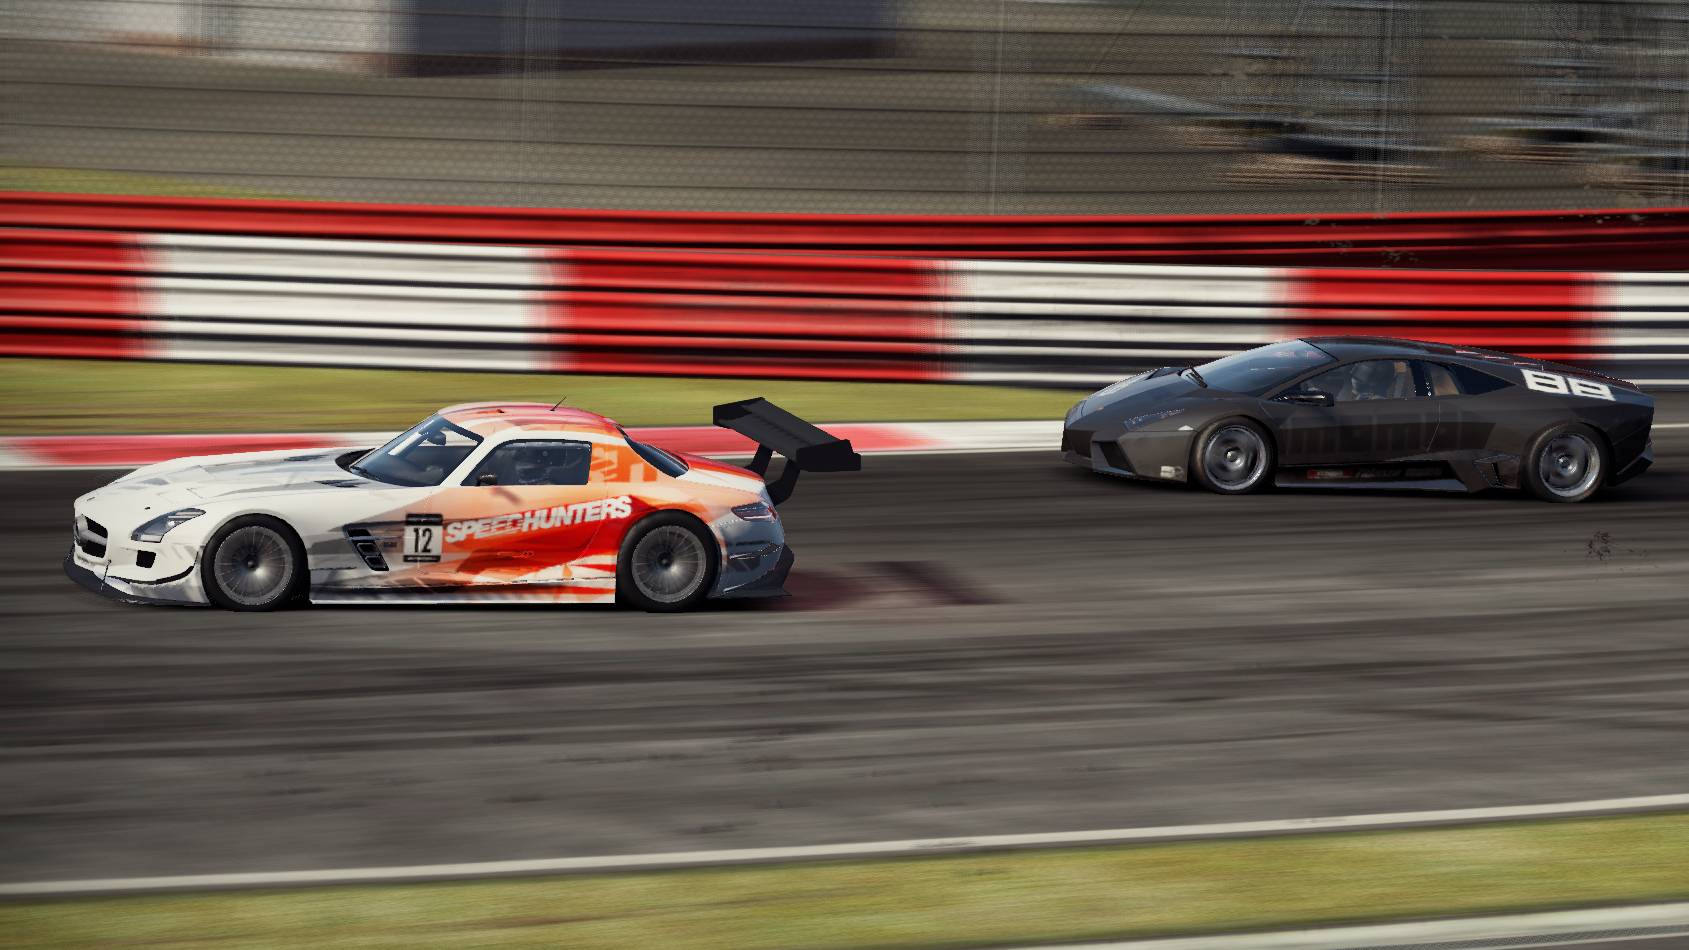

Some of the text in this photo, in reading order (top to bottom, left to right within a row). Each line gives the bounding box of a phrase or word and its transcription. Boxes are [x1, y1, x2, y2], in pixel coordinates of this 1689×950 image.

[1520, 369, 1616, 401] 88
[445, 496, 632, 543] SPEEDHUNTERS
[413, 527, 432, 553] 12
